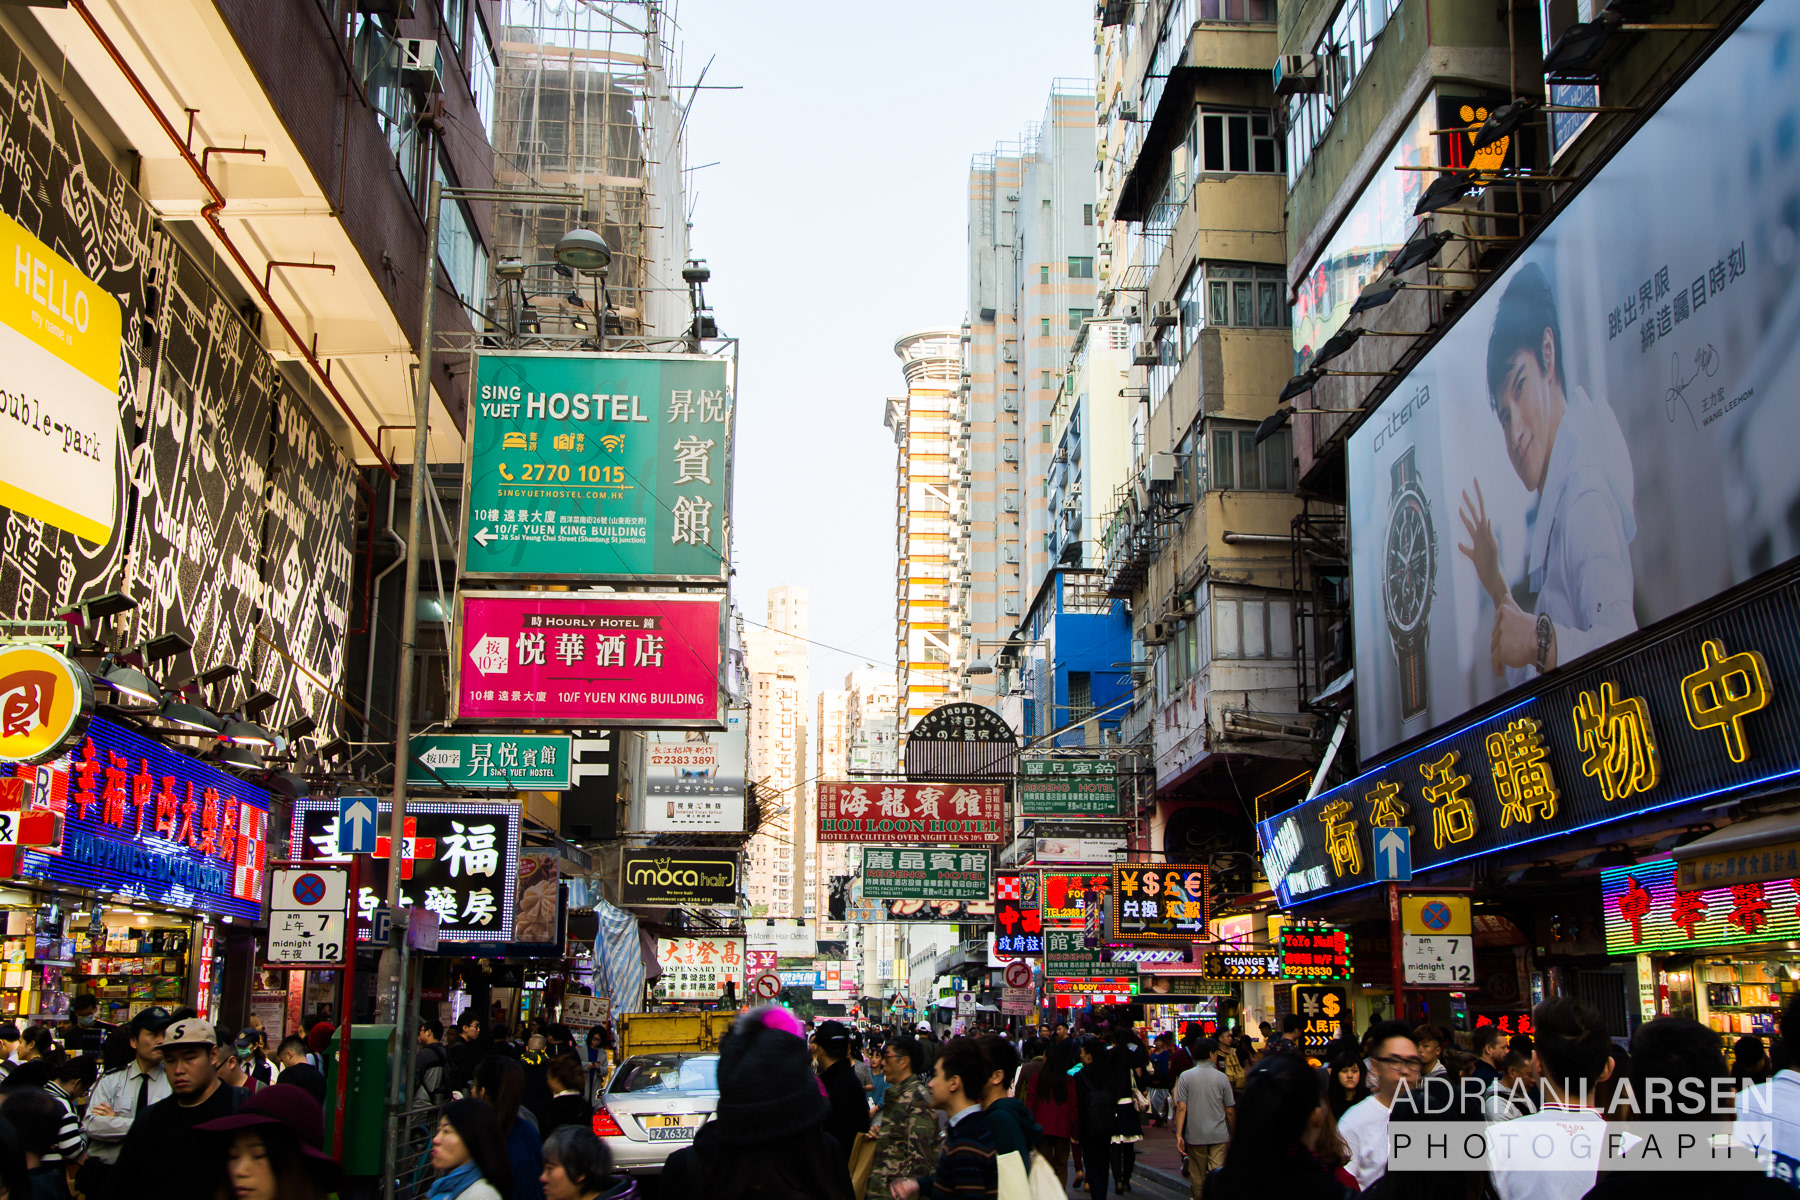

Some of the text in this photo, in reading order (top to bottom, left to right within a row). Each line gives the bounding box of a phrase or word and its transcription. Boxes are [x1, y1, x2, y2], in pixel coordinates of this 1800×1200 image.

[15, 243, 90, 334] HELLO
[1608, 265, 1670, 341] 跳出界限
[1640, 241, 1746, 353] 締造矚目時刻
[31, 309, 73, 346] my name is
[481, 386, 521, 400] SING
[1701, 387, 1725, 413] 王力宏
[481, 392, 649, 422] YUET HOSTEL
[1702, 387, 1754, 427] WANG LEEHOM
[1374, 384, 1431, 454] criteria
[278, 393, 323, 470] SOHO
[215, 397, 237, 491] Broome
[529, 431, 538, 452] 套房
[576, 433, 585, 453] 寄存
[521, 464, 625, 483] 2770 1015
[298, 474, 321, 521] Prince
[498, 489, 624, 499] SINGYUETHOSTEL.COM.HK
[670, 435, 715, 547] 賓館
[474, 509, 499, 522] 10樓
[503, 510, 556, 523] 遠景大廈
[196, 496, 219, 568] Grand
[494, 524, 646, 537] 10/F YUEN KING BUILDING
[522, 535, 541, 543] Yeung
[578, 535, 610, 544] (Shantung
[619, 536, 646, 544] junction)
[287, 558, 299, 590] 22
[190, 581, 209, 638] West
[486, 639, 500, 655] 按
[478, 655, 508, 670] 10字
[470, 690, 547, 703] 10樓 遠景大廈
[558, 691, 704, 705] 10/F YUEN KING BUILDING
[426, 752, 460, 765] 按10字
[664, 756, 715, 764] 2383 3891
[490, 768, 554, 777] SING YUET HOSTEL
[1026, 762, 1116, 782] 麗晶賓館
[1023, 783, 1115, 792] REGENG HOTEL
[840, 787, 982, 819] 海龍賓館
[821, 819, 1000, 833] HOI LOON HOTEL
[949, 834, 969, 842] LESS
[70, 832, 153, 877] HAPPINESS
[441, 821, 499, 877] 福
[866, 851, 987, 871] 麗晶賓館
[700, 873, 729, 887] hair
[867, 870, 985, 880] REGENG HOTEL
[895, 879, 922, 887] 酒店設備
[952, 880, 987, 888] 歡迎自由行
[282, 921, 305, 932] 上午
[317, 915, 330, 931] 7
[999, 935, 1044, 951] 政府註
[1284, 934, 1311, 947] YoYo
[1447, 939, 1459, 954] 7
[273, 939, 338, 960] midnight 12
[281, 949, 303, 960] 午夜
[1048, 953, 1093, 961] REGENG
[1224, 957, 1265, 966] CHANGE
[1418, 973, 1437, 981] 午夜
[1450, 966, 1471, 981] 12
[174, 1025, 186, 1039] S
[1556, 1122, 1585, 1132] PRADA
